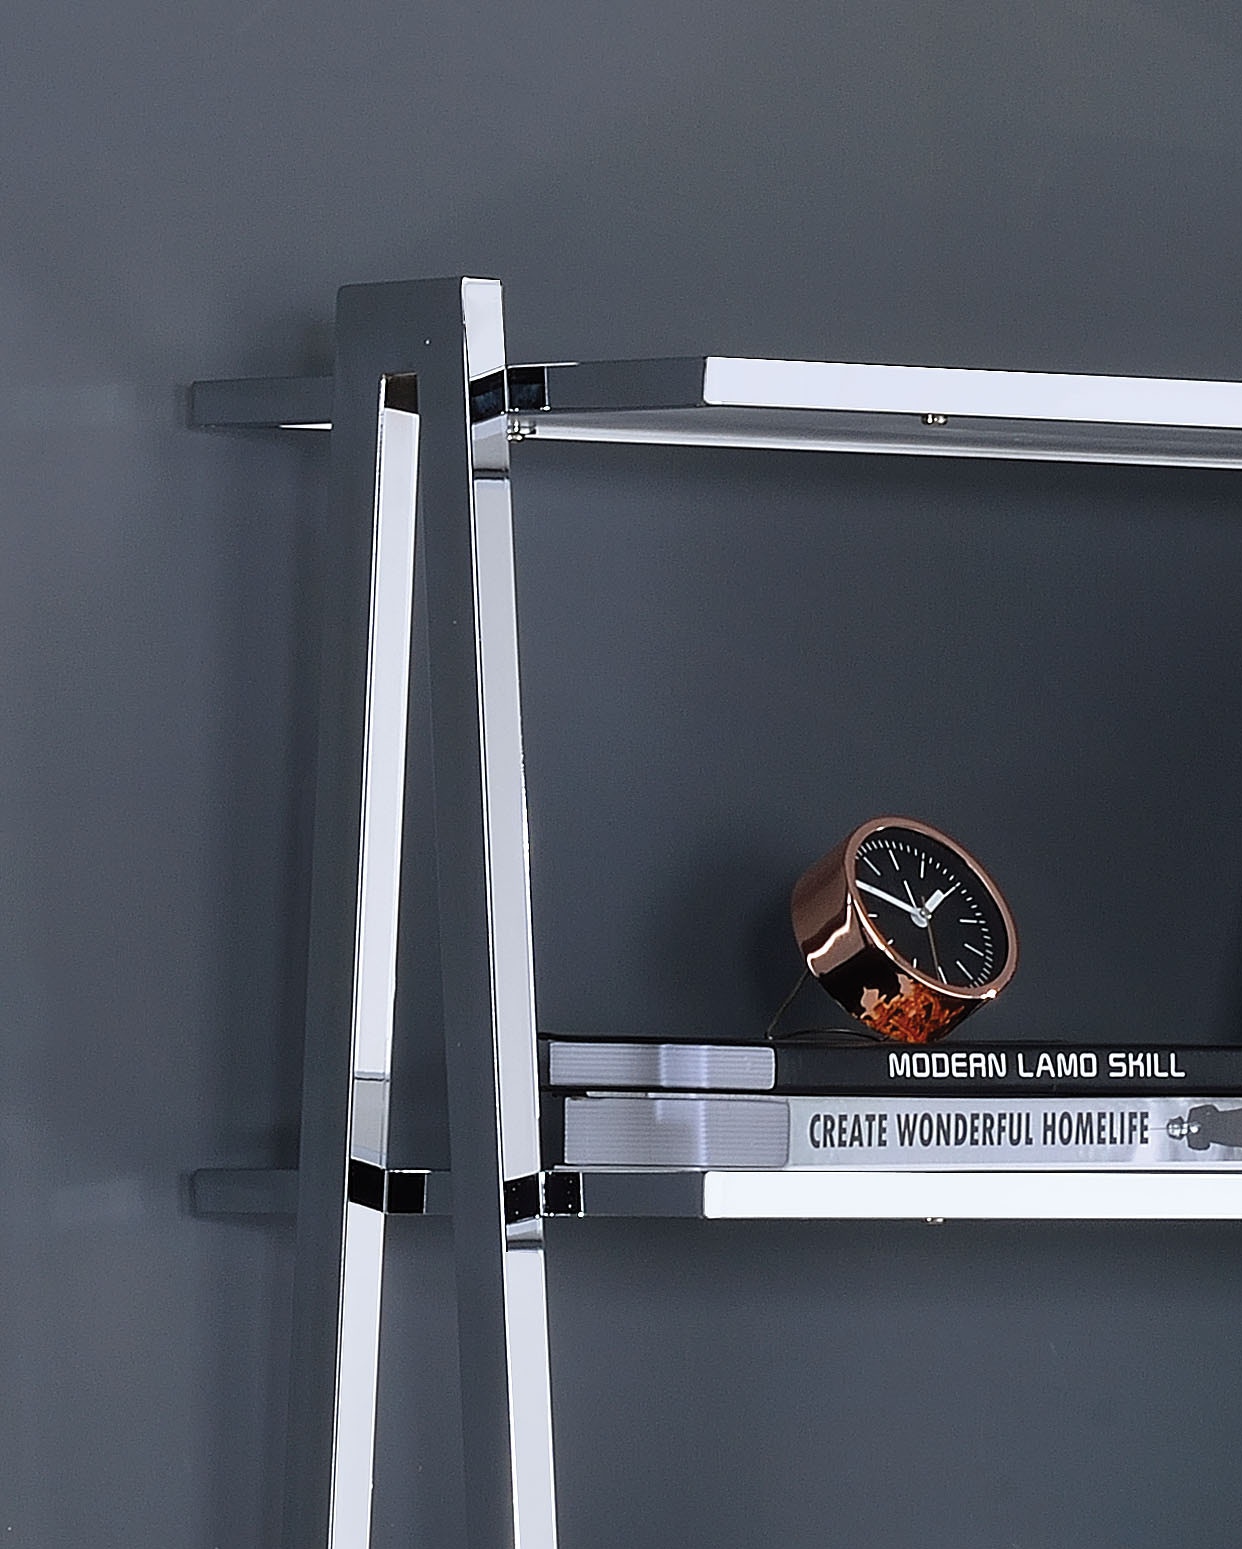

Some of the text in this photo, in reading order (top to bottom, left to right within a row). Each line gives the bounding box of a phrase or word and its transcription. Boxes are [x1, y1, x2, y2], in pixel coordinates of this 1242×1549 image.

[888, 1052, 1186, 1078] MODERN LAMO SKILL
[809, 1111, 1150, 1149] CREATE WONDERFUL HOMELIFE
